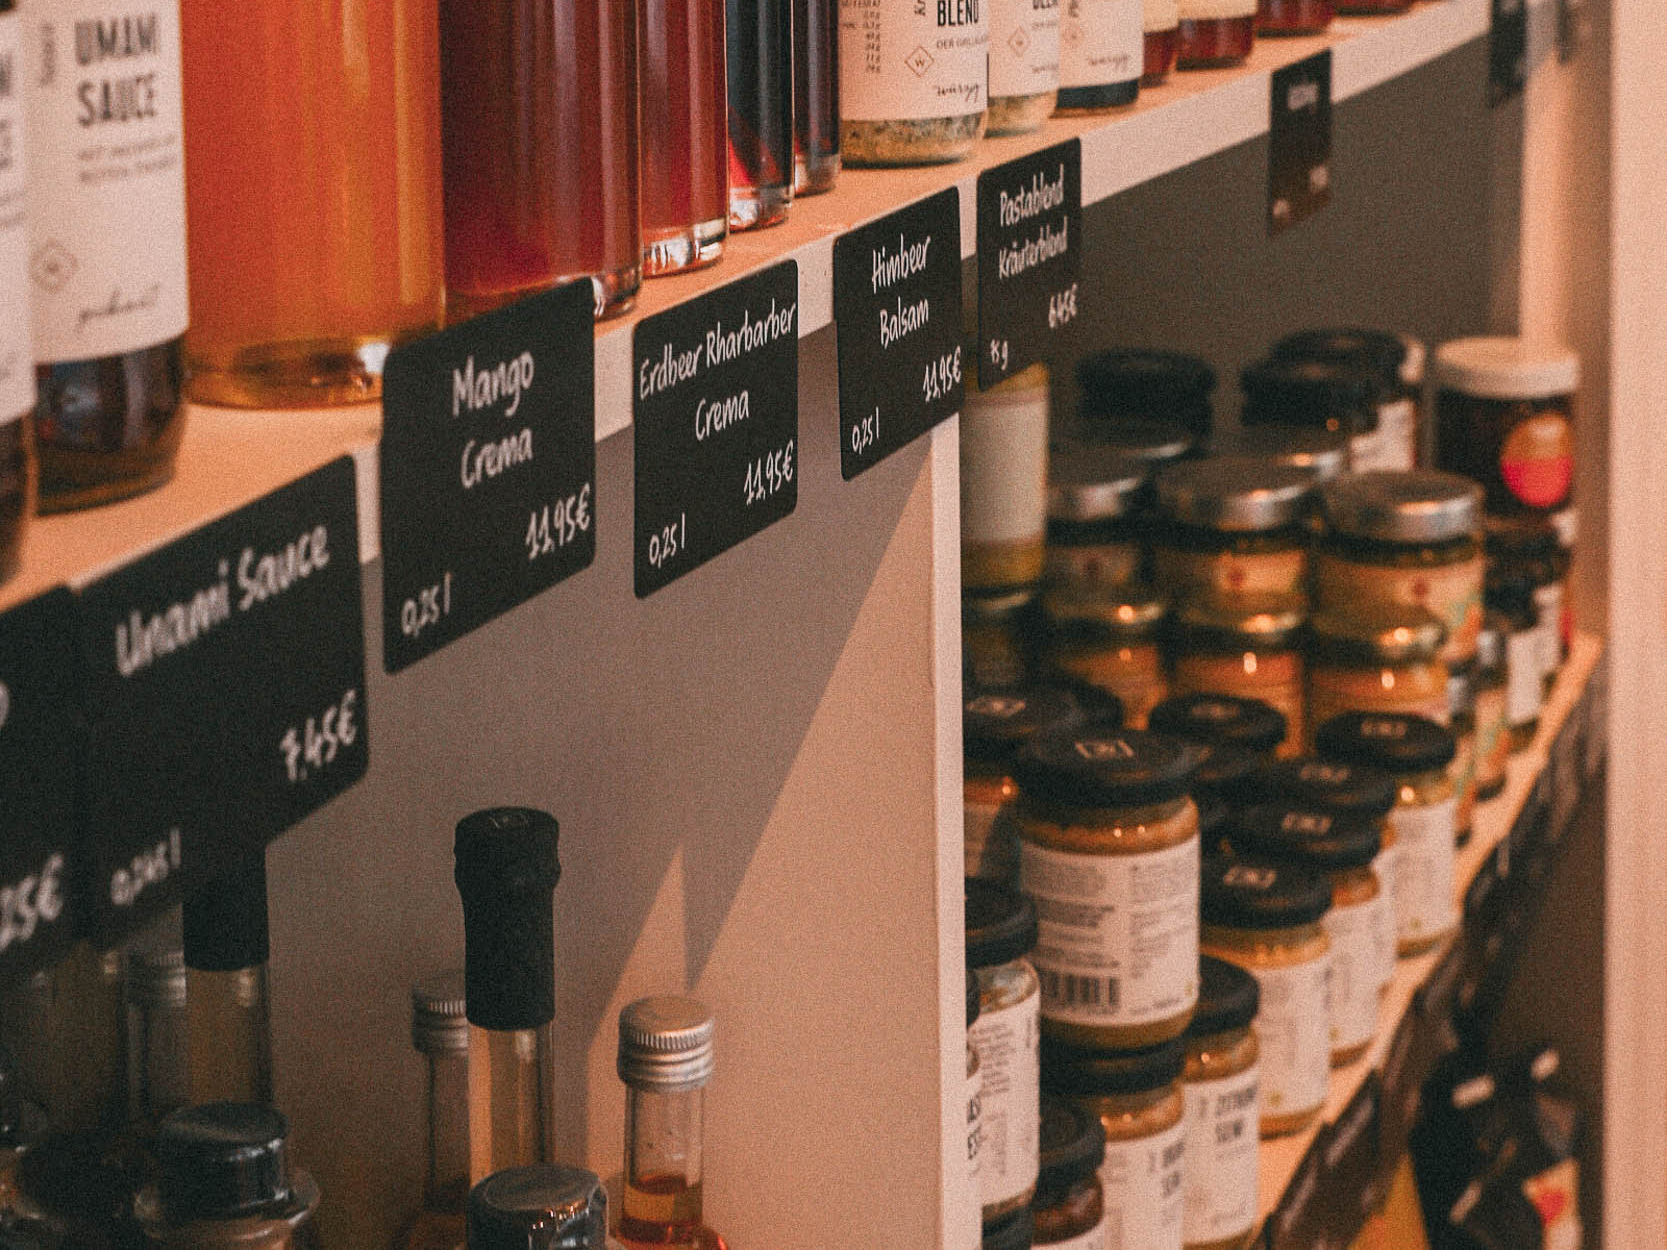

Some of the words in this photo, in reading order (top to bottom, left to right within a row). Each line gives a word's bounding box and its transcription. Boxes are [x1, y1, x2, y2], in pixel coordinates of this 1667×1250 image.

[1000, 163, 1065, 227] Pastablend
[872, 233, 932, 294] Himbeer
[640, 343, 703, 400] Erdbeer
[706, 299, 797, 368] Rharbarber
[880, 296, 929, 350] Balsam
[452, 352, 535, 418] Mango
[923, 346, 961, 402] 11,95€
[695, 390, 751, 442] Crema
[852, 414, 873, 454] 0,25
[461, 427, 533, 488] Crema
[744, 439, 794, 506] 11,95€
[526, 483, 591, 561] 11,95€
[649, 523, 678, 568] 0,25
[236, 525, 330, 611] Sauce
[280, 689, 358, 781] 7,45€
